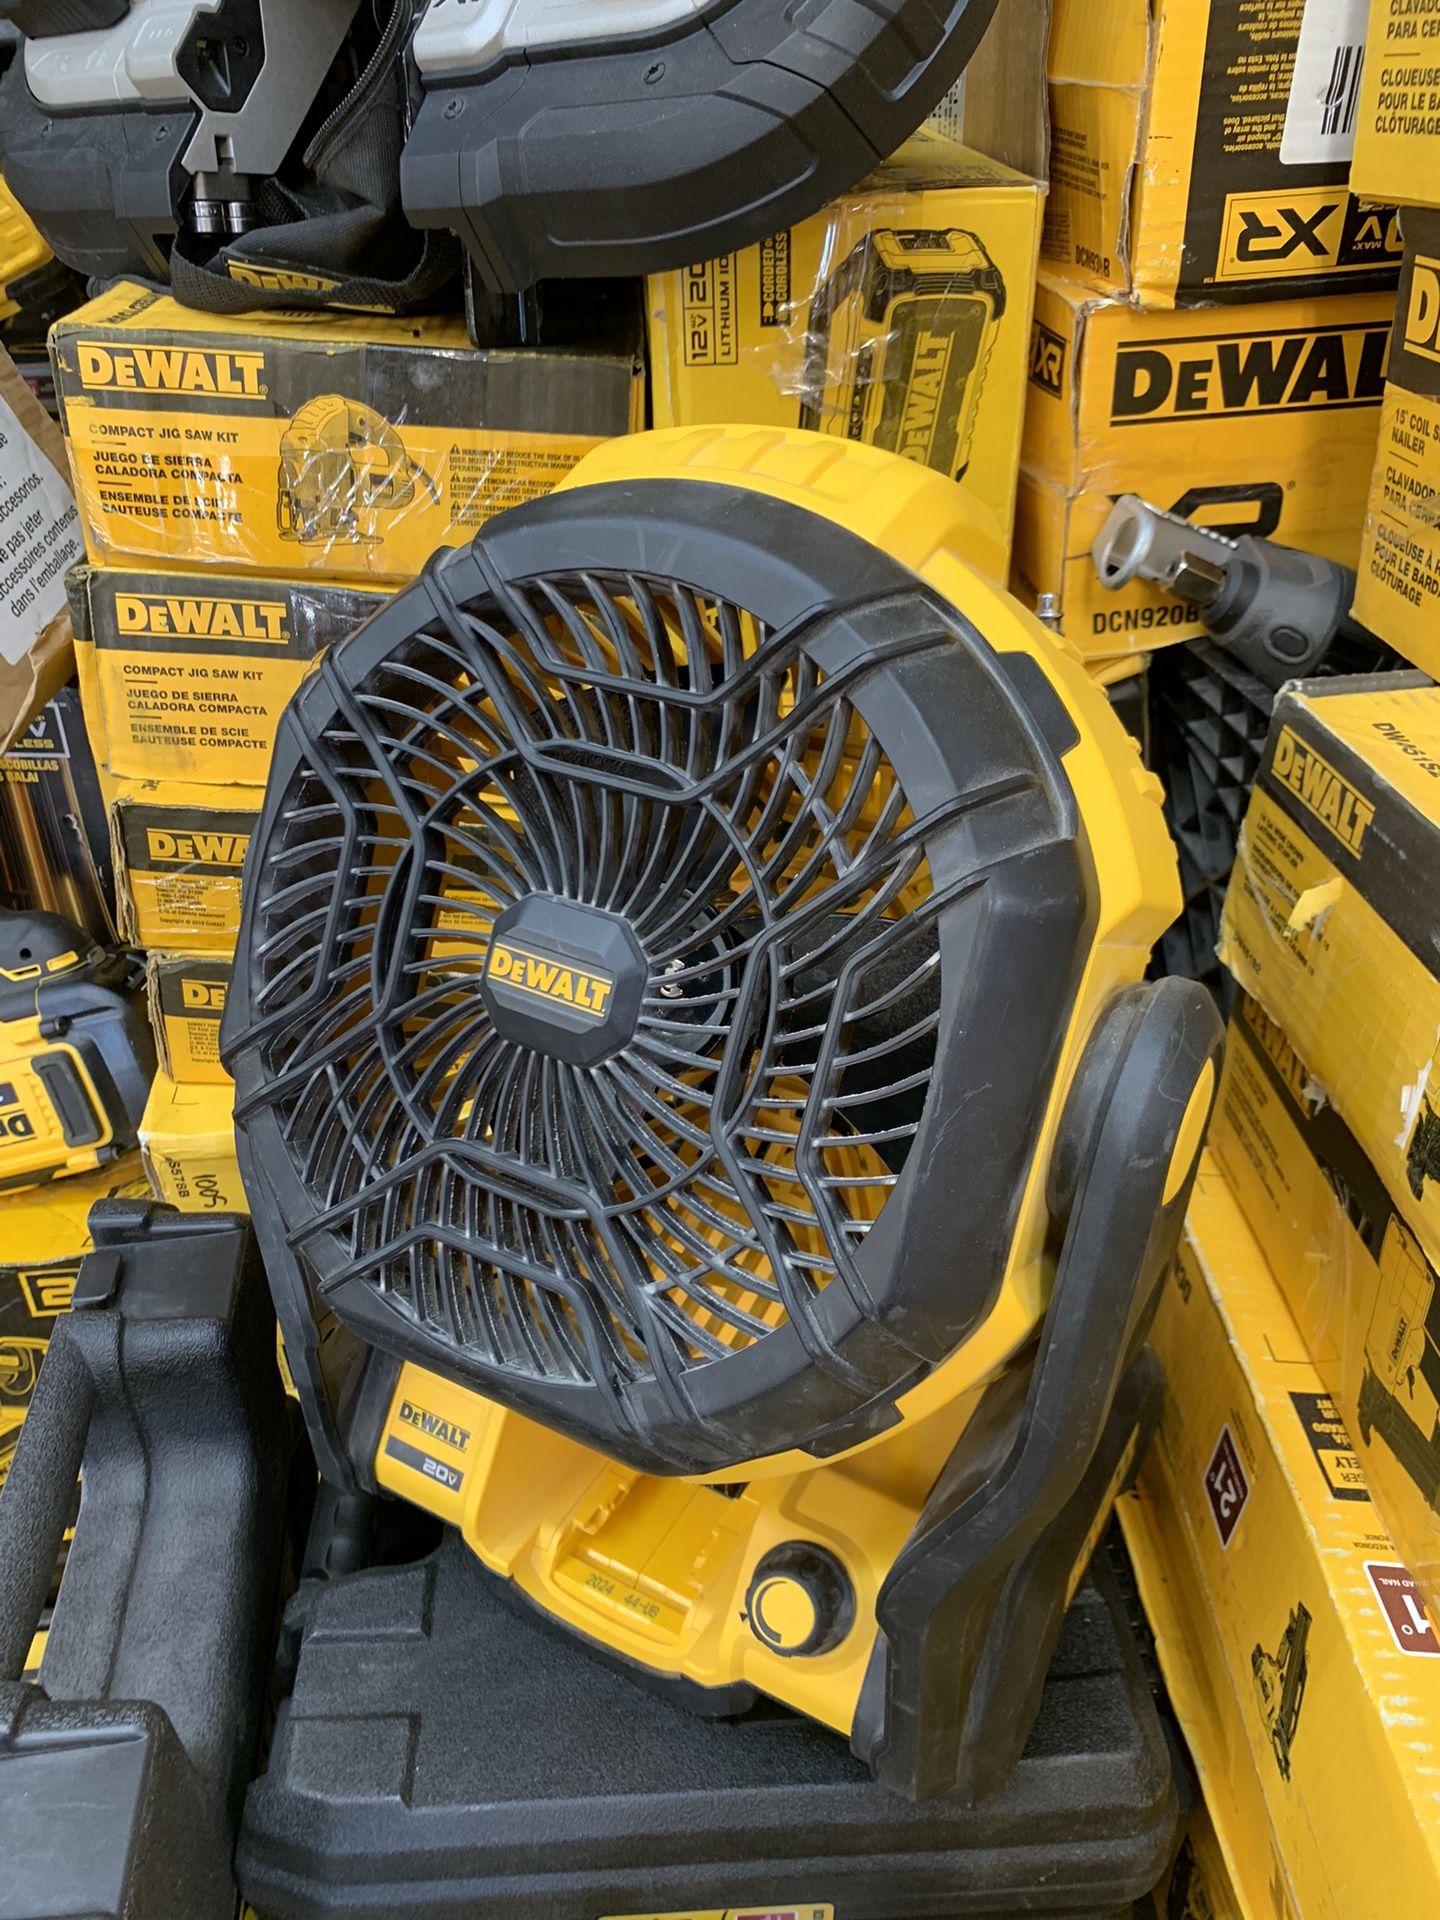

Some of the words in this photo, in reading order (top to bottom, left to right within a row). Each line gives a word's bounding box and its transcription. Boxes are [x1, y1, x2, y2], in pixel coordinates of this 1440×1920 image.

[1386, 21, 1418, 40] PARA
[1381, 67, 1440, 87] CLOUEUSE
[1377, 91, 1408, 111] POUR
[1410, 92, 1426, 111] LE
[1375, 111, 1440, 136] CLÔTURAGE
[1236, 204, 1340, 263] XR
[762, 248, 775, 302] CORDED
[775, 232, 788, 302] CORDLESS
[719, 281, 731, 356] LITHIUM
[77, 347, 265, 395] DEWALT
[89, 423, 154, 438] COMPACT
[158, 428, 181, 440] JIG
[184, 429, 213, 441] SAW
[216, 431, 239, 443] KIT
[1409, 413, 1430, 438] COIL
[1391, 426, 1425, 457] NAILER
[93, 451, 138, 465] JUEGO
[164, 455, 212, 468] SIERRA
[95, 465, 168, 479] CALADORA
[100, 490, 169, 505] ENSEMBLE
[173, 494, 190, 506] DE
[1383, 485, 1407, 513] PARA
[6, 530, 26, 557] pas
[20, 509, 44, 541] jeter
[43, 504, 79, 547] contenus
[1377, 522, 1424, 565] CLOUEUSE
[1424, 549, 1433, 571] À
[10, 588, 36, 619] dans
[29, 539, 80, 594] l'emballage.
[1398, 557, 1410, 578] LE
[115, 597, 288, 640] DEWALT
[123, 664, 185, 677] COMPACT
[188, 667, 209, 678] JIG
[212, 668, 239, 680] SAW
[243, 670, 264, 681] KIT
[126, 688, 169, 699] JUEGO
[172, 690, 189, 700] DE
[192, 691, 239, 703] SIERRA
[128, 701, 196, 713] CALADORA
[199, 703, 268, 716] COMPACTA
[130, 723, 198, 735] ENSEMBLE
[200, 726, 218, 737] DE
[221, 727, 249, 738] SCIE
[132, 734, 196, 747] SAUTEUSE
[199, 738, 268, 750] COMPACTE
[1271, 733, 1375, 850] DEWALT
[488, 947, 612, 1011] DEWALT
[399, 1402, 471, 1449] DEWALT
[422, 1457, 458, 1486] 20V
[1352, 1541, 1389, 1552] REDONDA
